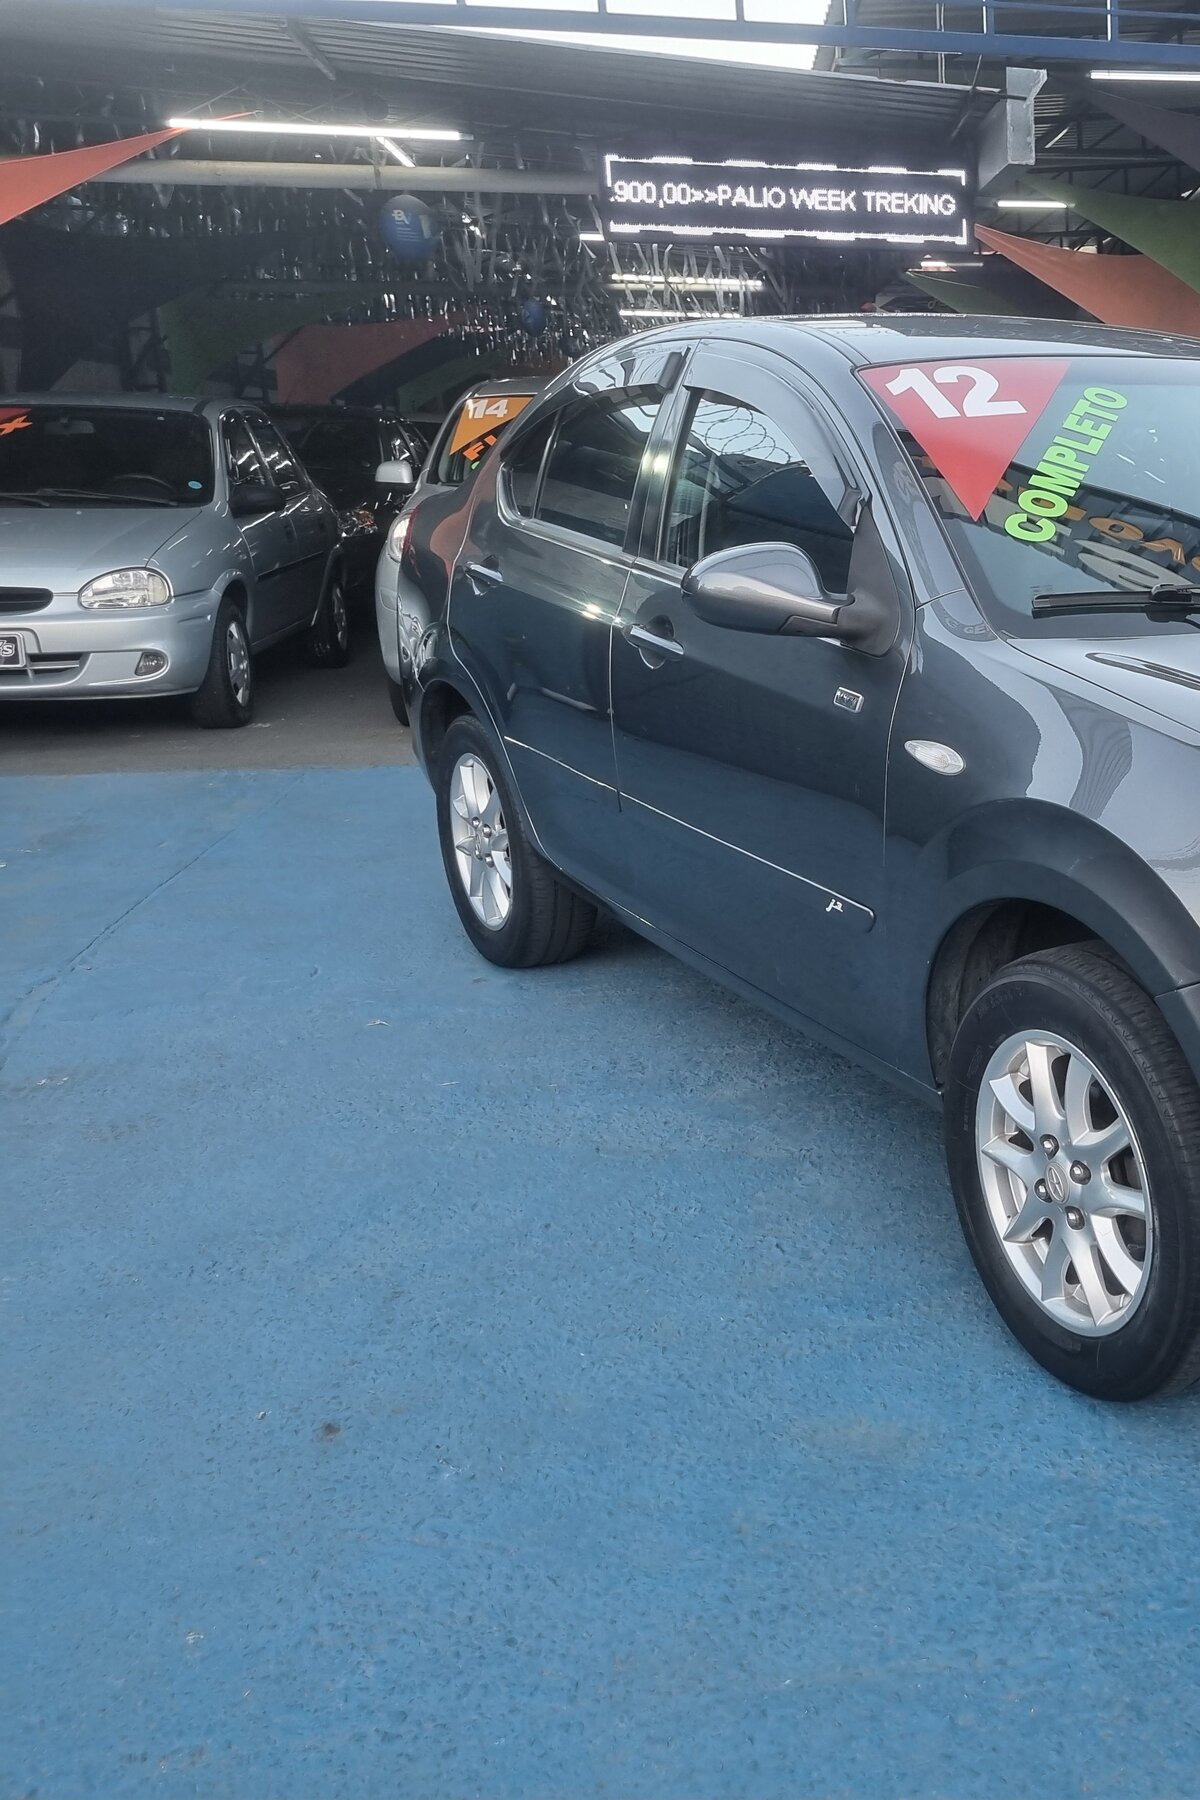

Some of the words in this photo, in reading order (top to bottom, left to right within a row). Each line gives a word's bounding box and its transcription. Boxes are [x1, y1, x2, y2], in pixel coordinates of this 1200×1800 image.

[790, 188, 857, 212] WEEK
[862, 190, 956, 216] TREKING
[884, 365, 1028, 419] 12
[1003, 386, 1129, 544] COMPLETO
